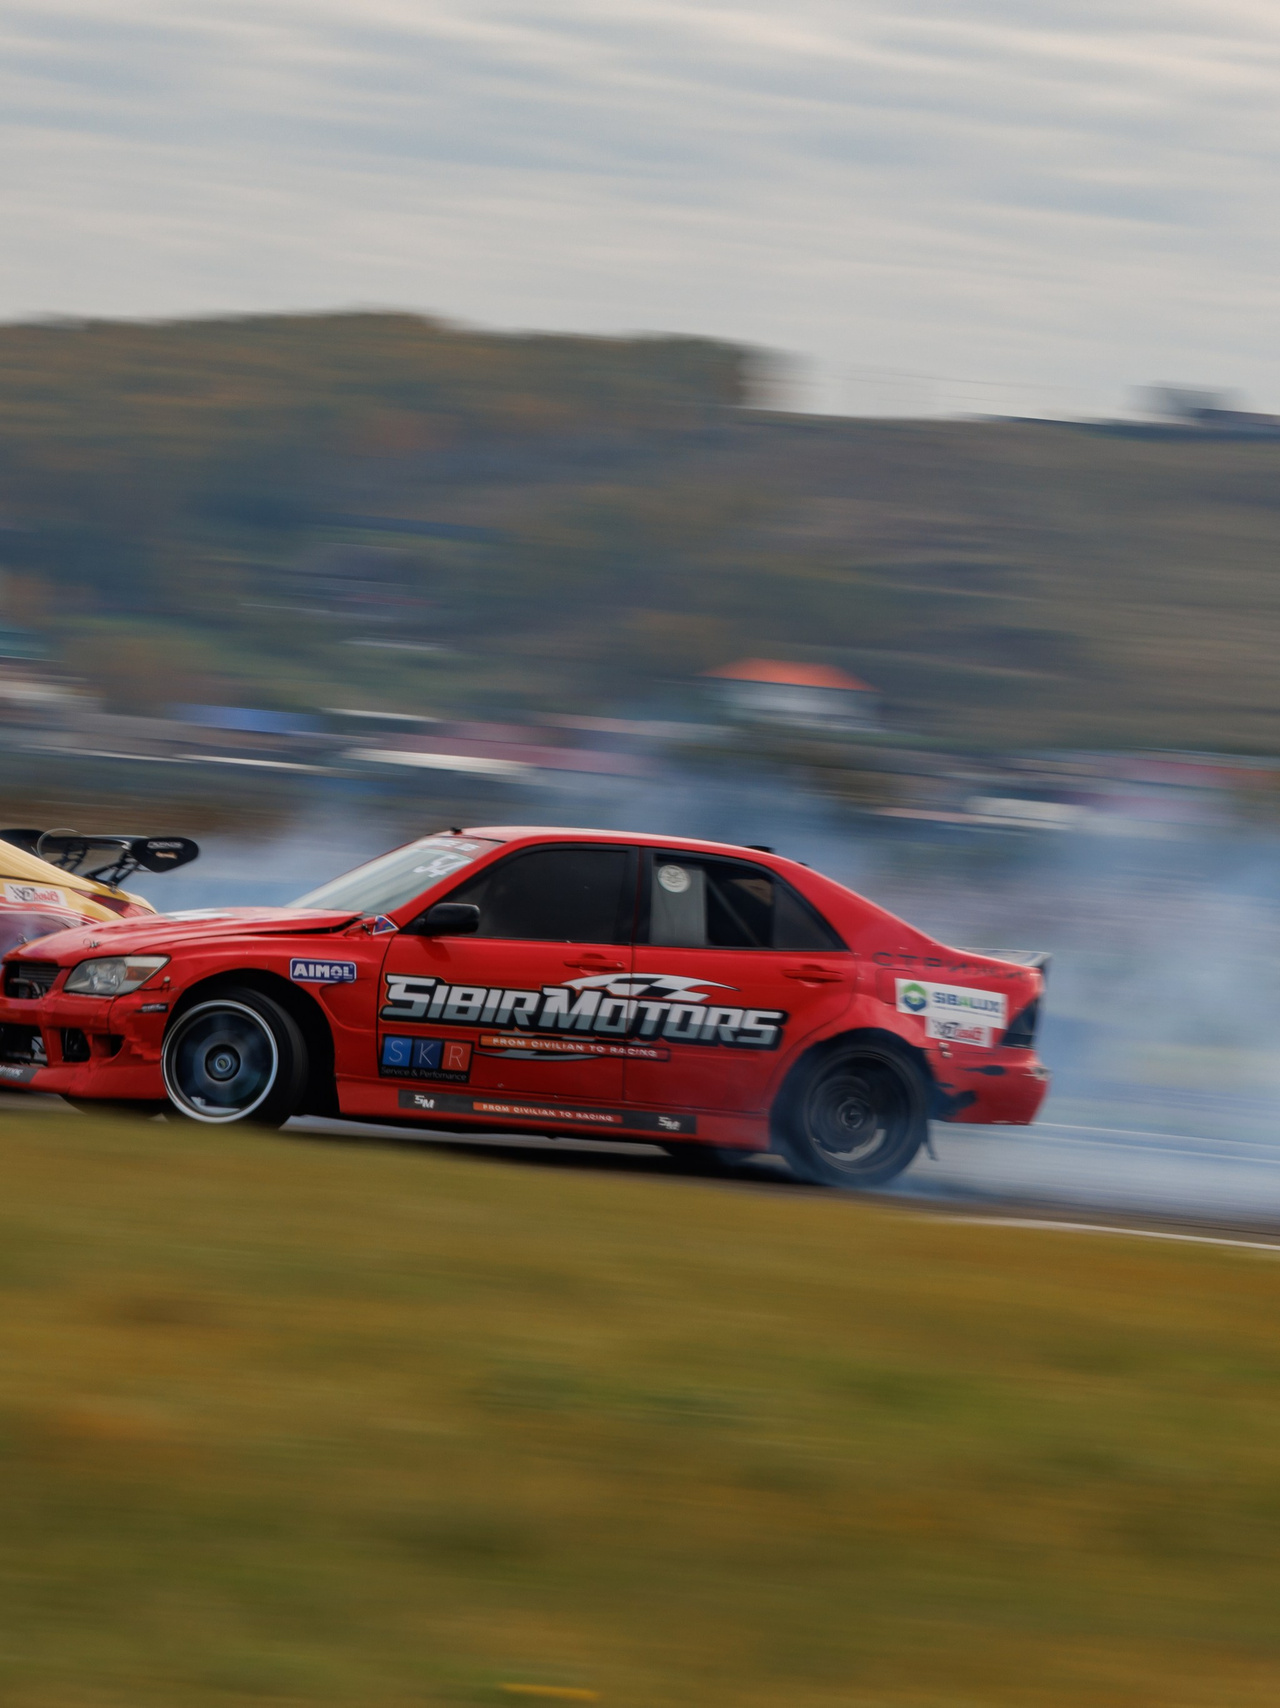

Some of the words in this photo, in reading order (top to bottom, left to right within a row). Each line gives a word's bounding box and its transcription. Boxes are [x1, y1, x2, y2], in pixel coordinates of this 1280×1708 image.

[293, 963, 353, 979] AIMOL
[492, 1037, 527, 1047] FROM
[531, 1040, 585, 1051] CIVILIAN
[589, 1045, 605, 1053] TO
[609, 1046, 658, 1058] RACING
[380, 1066, 410, 1076] Service
[411, 1069, 419, 1077] &
[482, 1103, 510, 1112] FROM
[513, 1106, 556, 1117] CIVILIAN
[559, 1110, 573, 1118] TO
[576, 1112, 614, 1122] RACING
